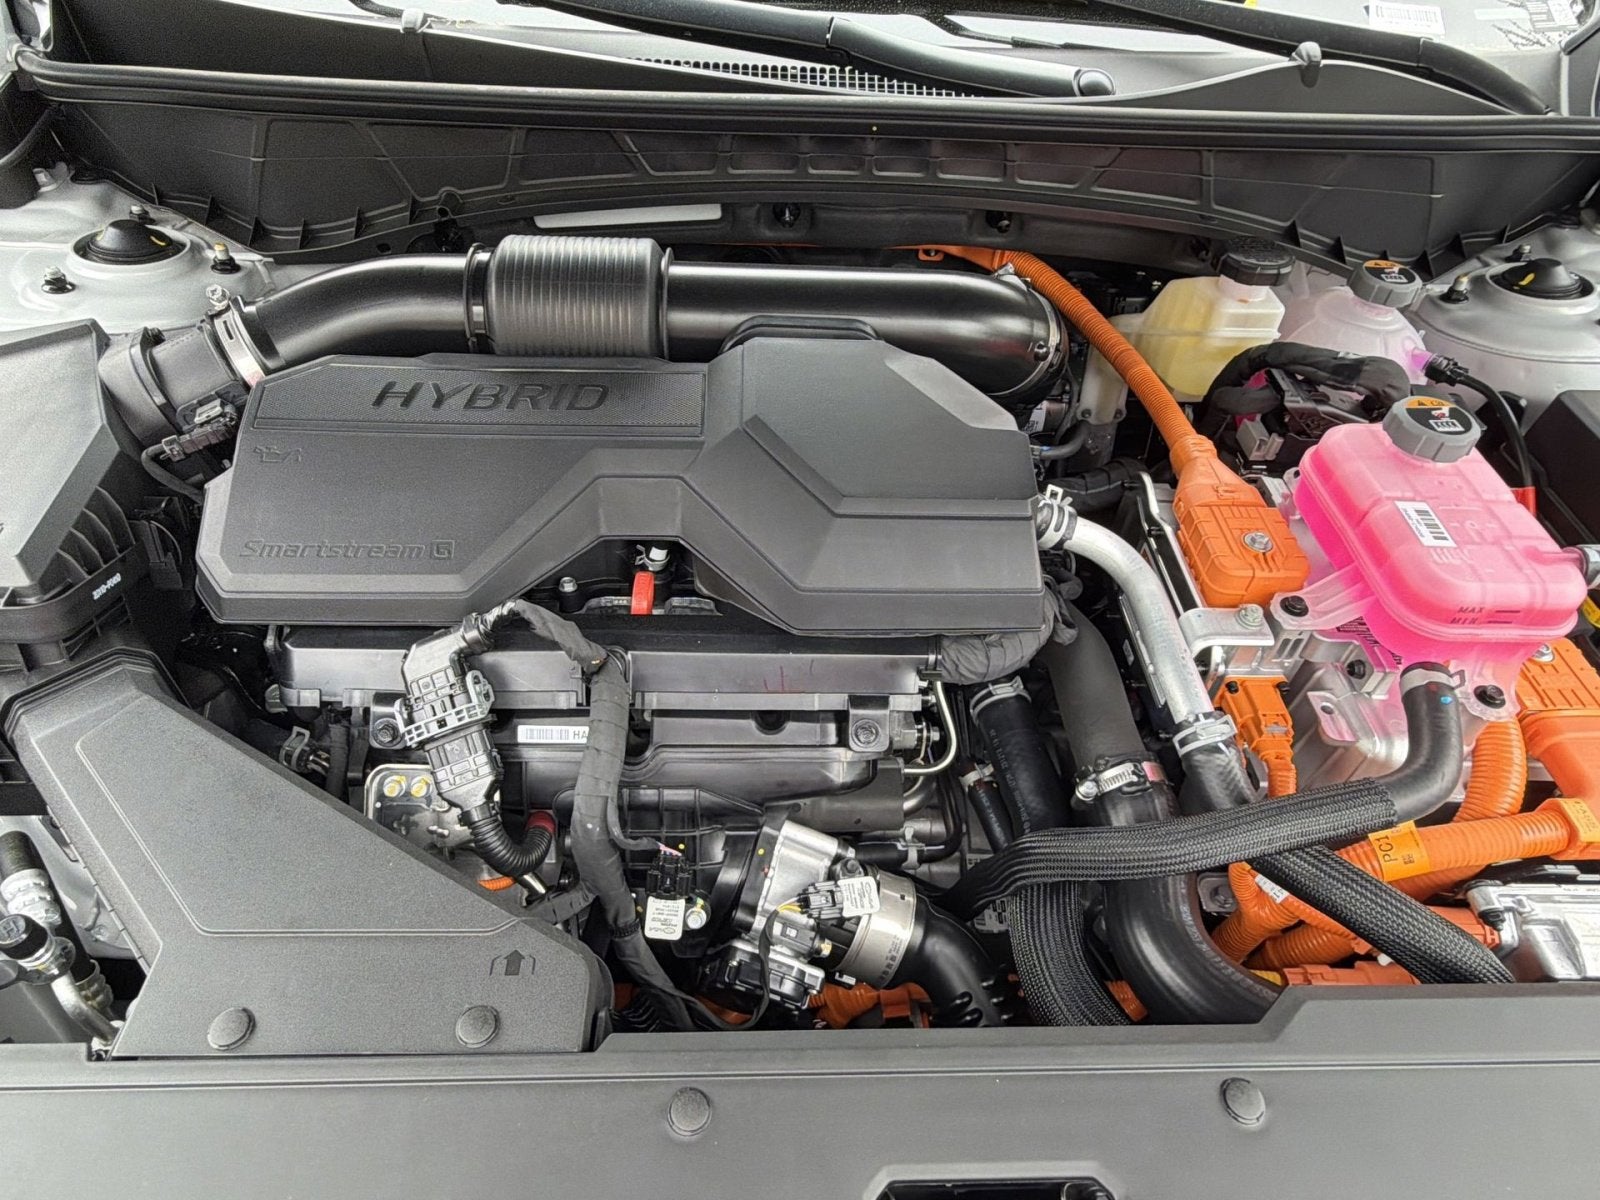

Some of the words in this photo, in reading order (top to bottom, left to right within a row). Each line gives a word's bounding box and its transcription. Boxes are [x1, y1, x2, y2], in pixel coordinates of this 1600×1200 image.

[371, 381, 609, 411] HYBRID
[239, 538, 426, 559] Smartstream
[1457, 606, 1485, 614] MAX
[1450, 617, 1479, 625] MIN
